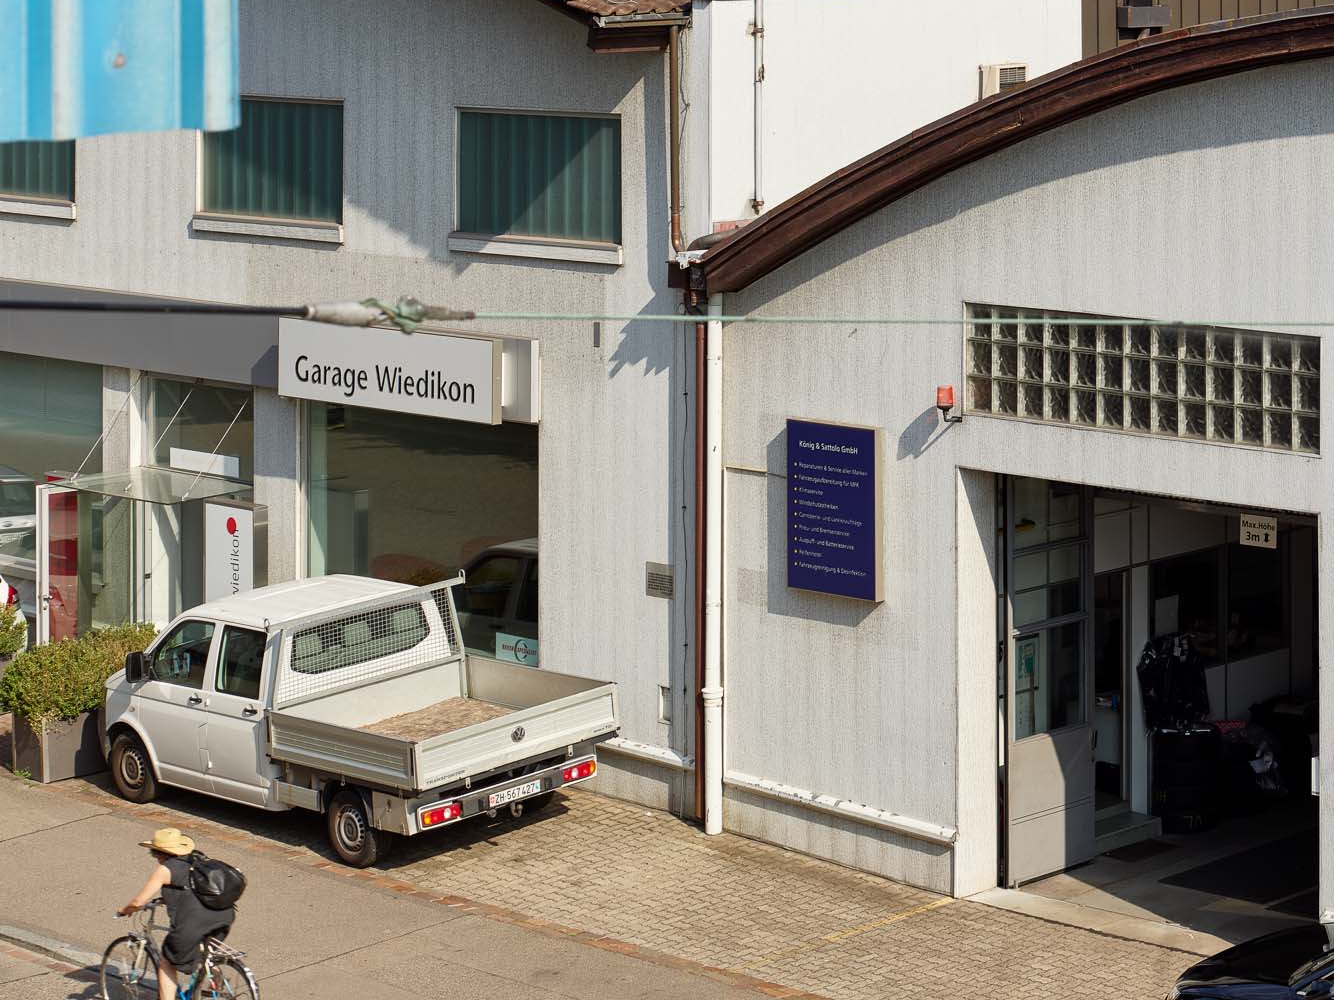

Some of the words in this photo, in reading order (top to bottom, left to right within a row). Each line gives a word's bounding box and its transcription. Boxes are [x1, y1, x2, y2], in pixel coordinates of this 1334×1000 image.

[295, 355, 368, 397] Garage
[375, 364, 475, 404] Wiedikon
[799, 440, 815, 451] König
[821, 443, 840, 453] Sattolo
[841, 445, 858, 455] GmbH
[1245, 531, 1260, 542] 3m
